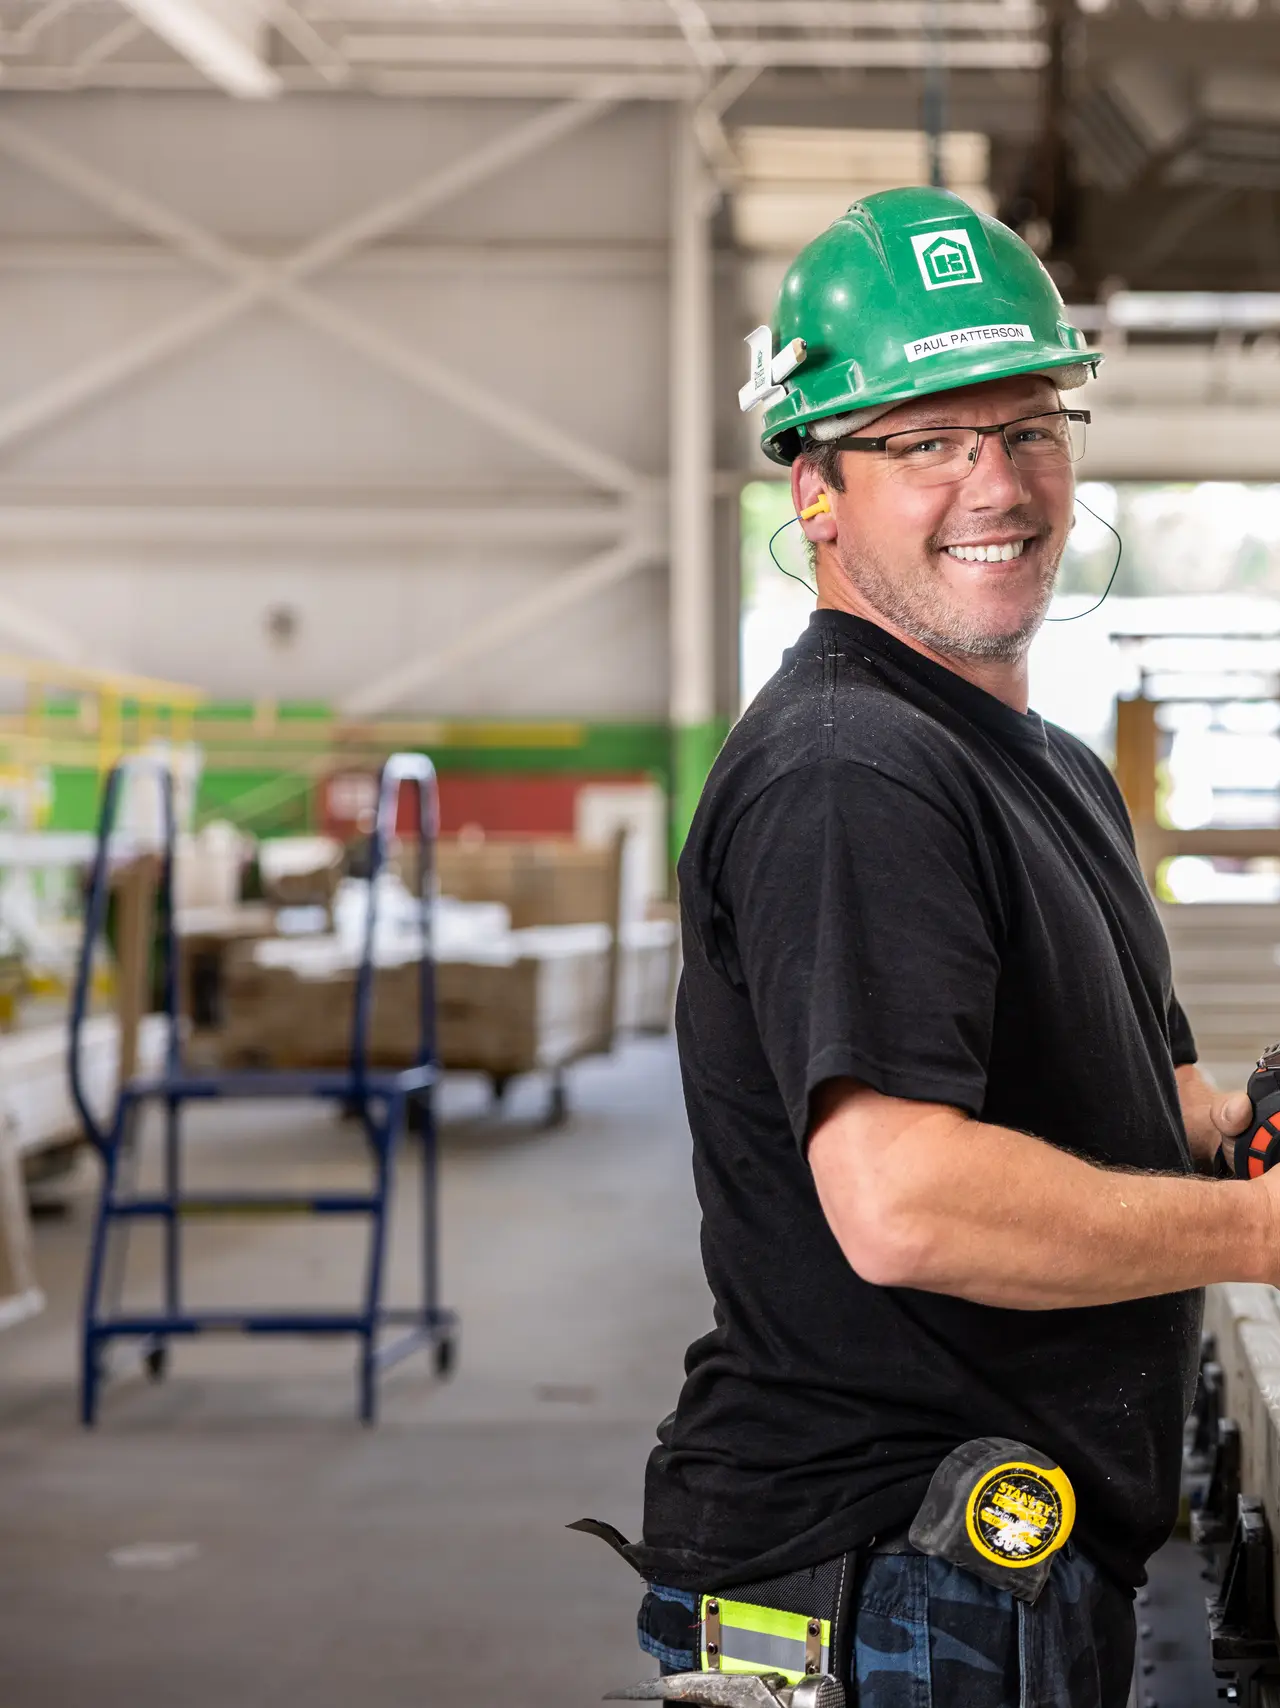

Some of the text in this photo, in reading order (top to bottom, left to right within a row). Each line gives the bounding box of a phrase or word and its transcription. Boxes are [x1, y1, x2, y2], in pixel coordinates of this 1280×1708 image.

[913, 327, 1025, 355] PAUL PATTERSON
[998, 1481, 1053, 1517] STANLEY
